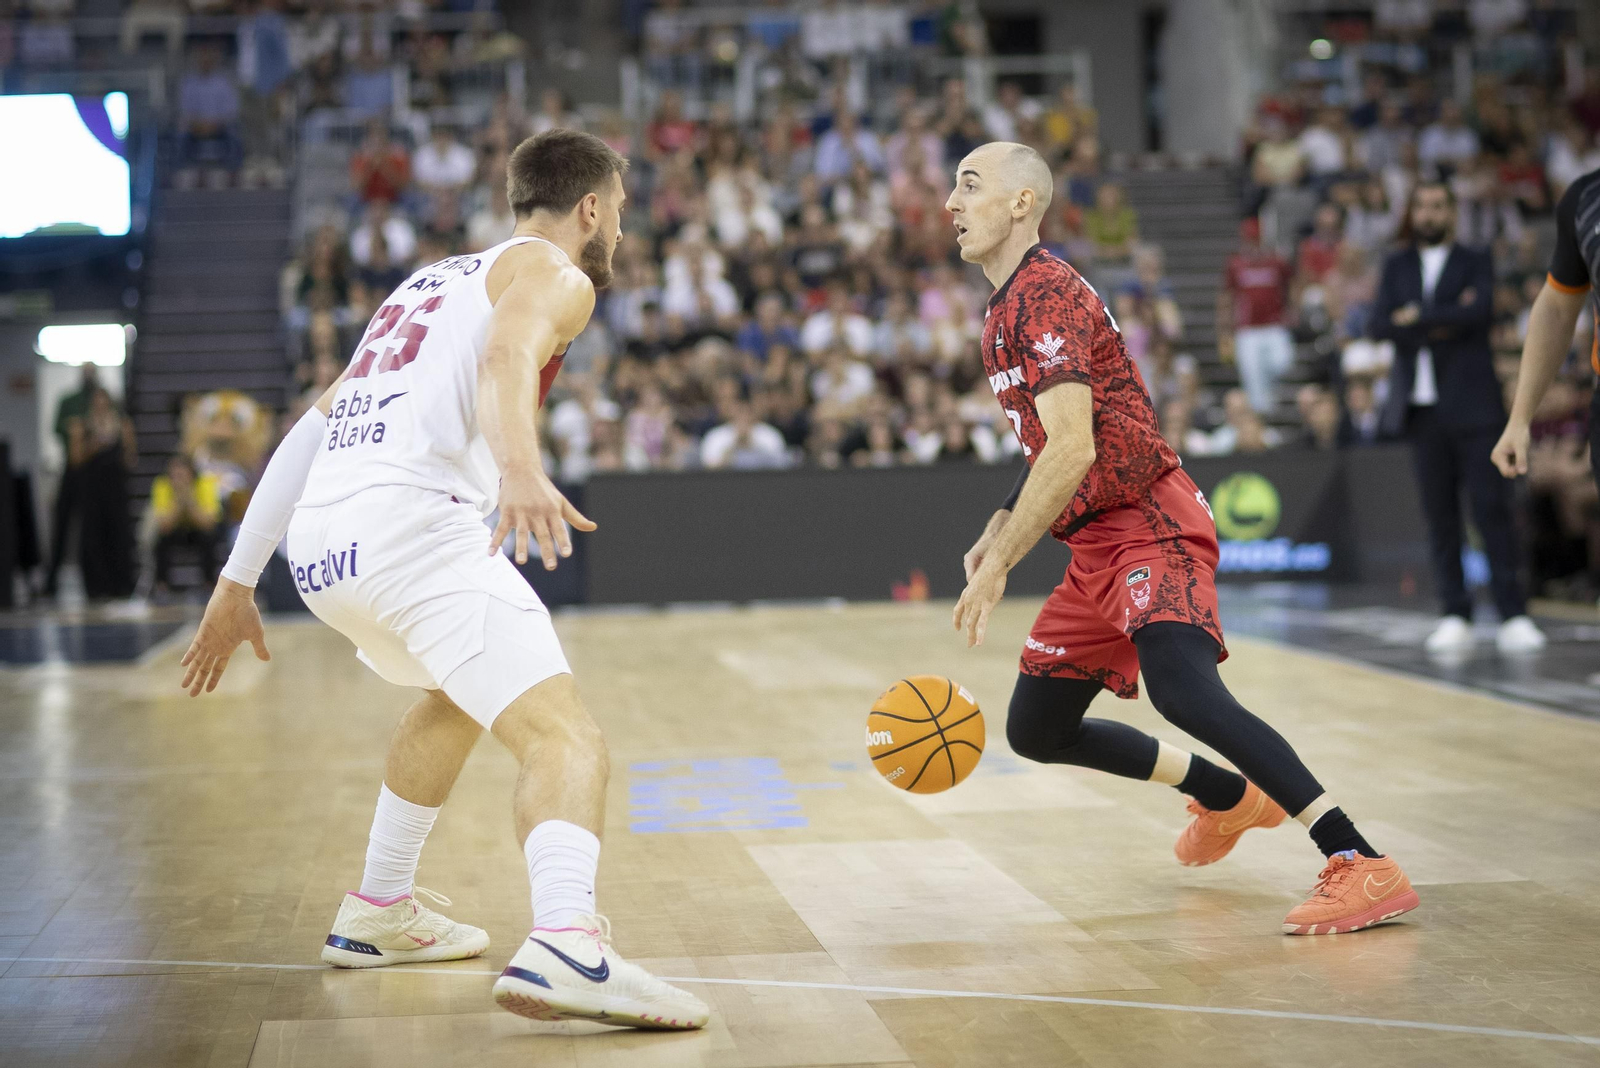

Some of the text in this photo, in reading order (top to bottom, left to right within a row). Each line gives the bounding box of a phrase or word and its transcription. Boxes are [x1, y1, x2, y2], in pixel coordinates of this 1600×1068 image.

[342, 293, 448, 382] 25
[328, 420, 386, 451] álava
[1128, 573, 1145, 583] acb
